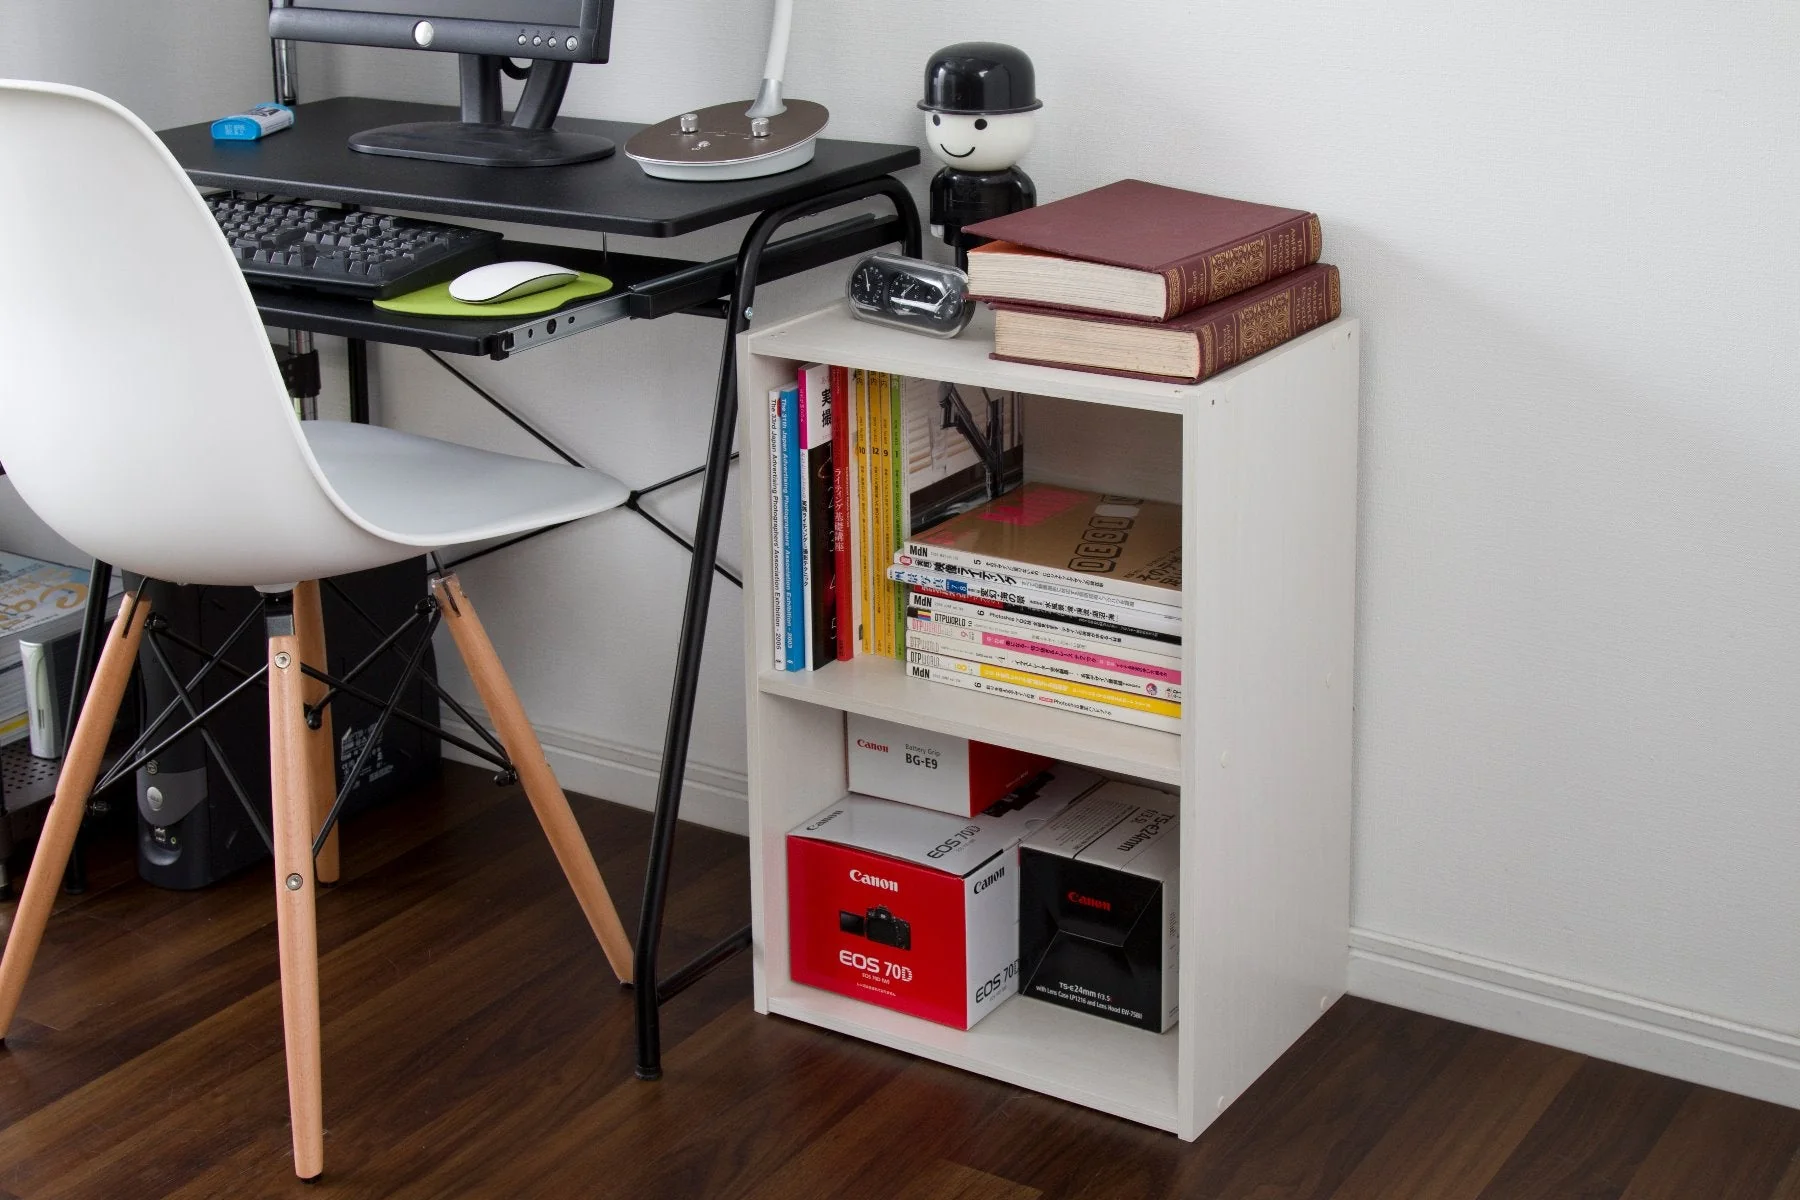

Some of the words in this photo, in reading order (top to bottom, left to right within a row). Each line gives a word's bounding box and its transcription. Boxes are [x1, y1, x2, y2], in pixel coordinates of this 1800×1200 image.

[871, 447, 879, 455] 12
[781, 453, 789, 494] Advertising
[771, 496, 779, 548] Photographers'
[782, 495, 790, 548] Photographers'
[909, 545, 928, 558] MdN
[913, 594, 932, 608] MdN
[934, 613, 966, 627] DTPWORLD
[912, 666, 930, 679] MdN
[856, 738, 889, 753] Canon
[905, 743, 926, 755] Battery
[927, 748, 941, 757] Grip
[905, 752, 938, 769] BG-E9
[806, 809, 844, 831] Canon
[926, 838, 961, 859] EOS
[954, 825, 981, 840] 70D
[849, 869, 899, 892] Canon
[973, 866, 1005, 895] Canon
[1067, 891, 1112, 912] Canon
[839, 949, 880, 974] EOS
[884, 961, 913, 982] 70D
[975, 972, 1001, 1004] EOS
[1036, 984, 1047, 993] with
[1047, 987, 1058, 996] Lens
[1058, 990, 1069, 1000] Case
[1087, 999, 1096, 1007] and
[1096, 1000, 1107, 1010] Lens
[1107, 1003, 1121, 1014] Hood
